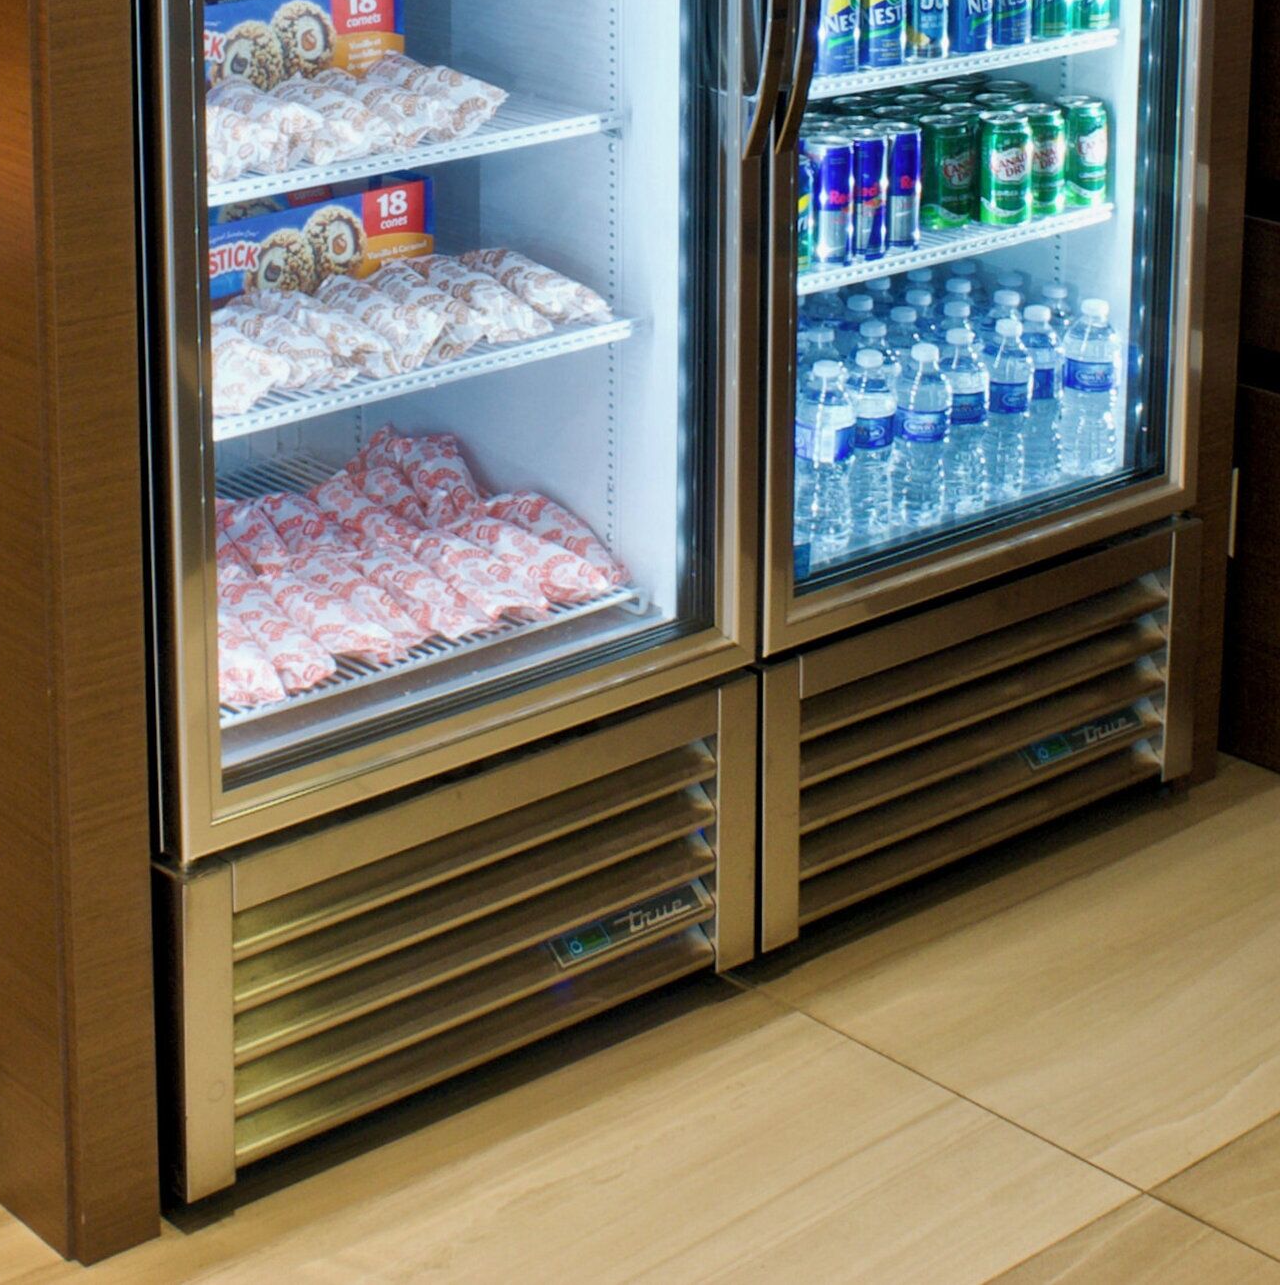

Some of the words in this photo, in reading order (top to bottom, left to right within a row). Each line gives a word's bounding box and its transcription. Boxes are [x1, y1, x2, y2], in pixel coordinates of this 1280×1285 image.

[346, 14, 383, 29] cornets
[377, 190, 408, 217] 18
[380, 215, 408, 229] cones
[209, 244, 260, 277] STICK
